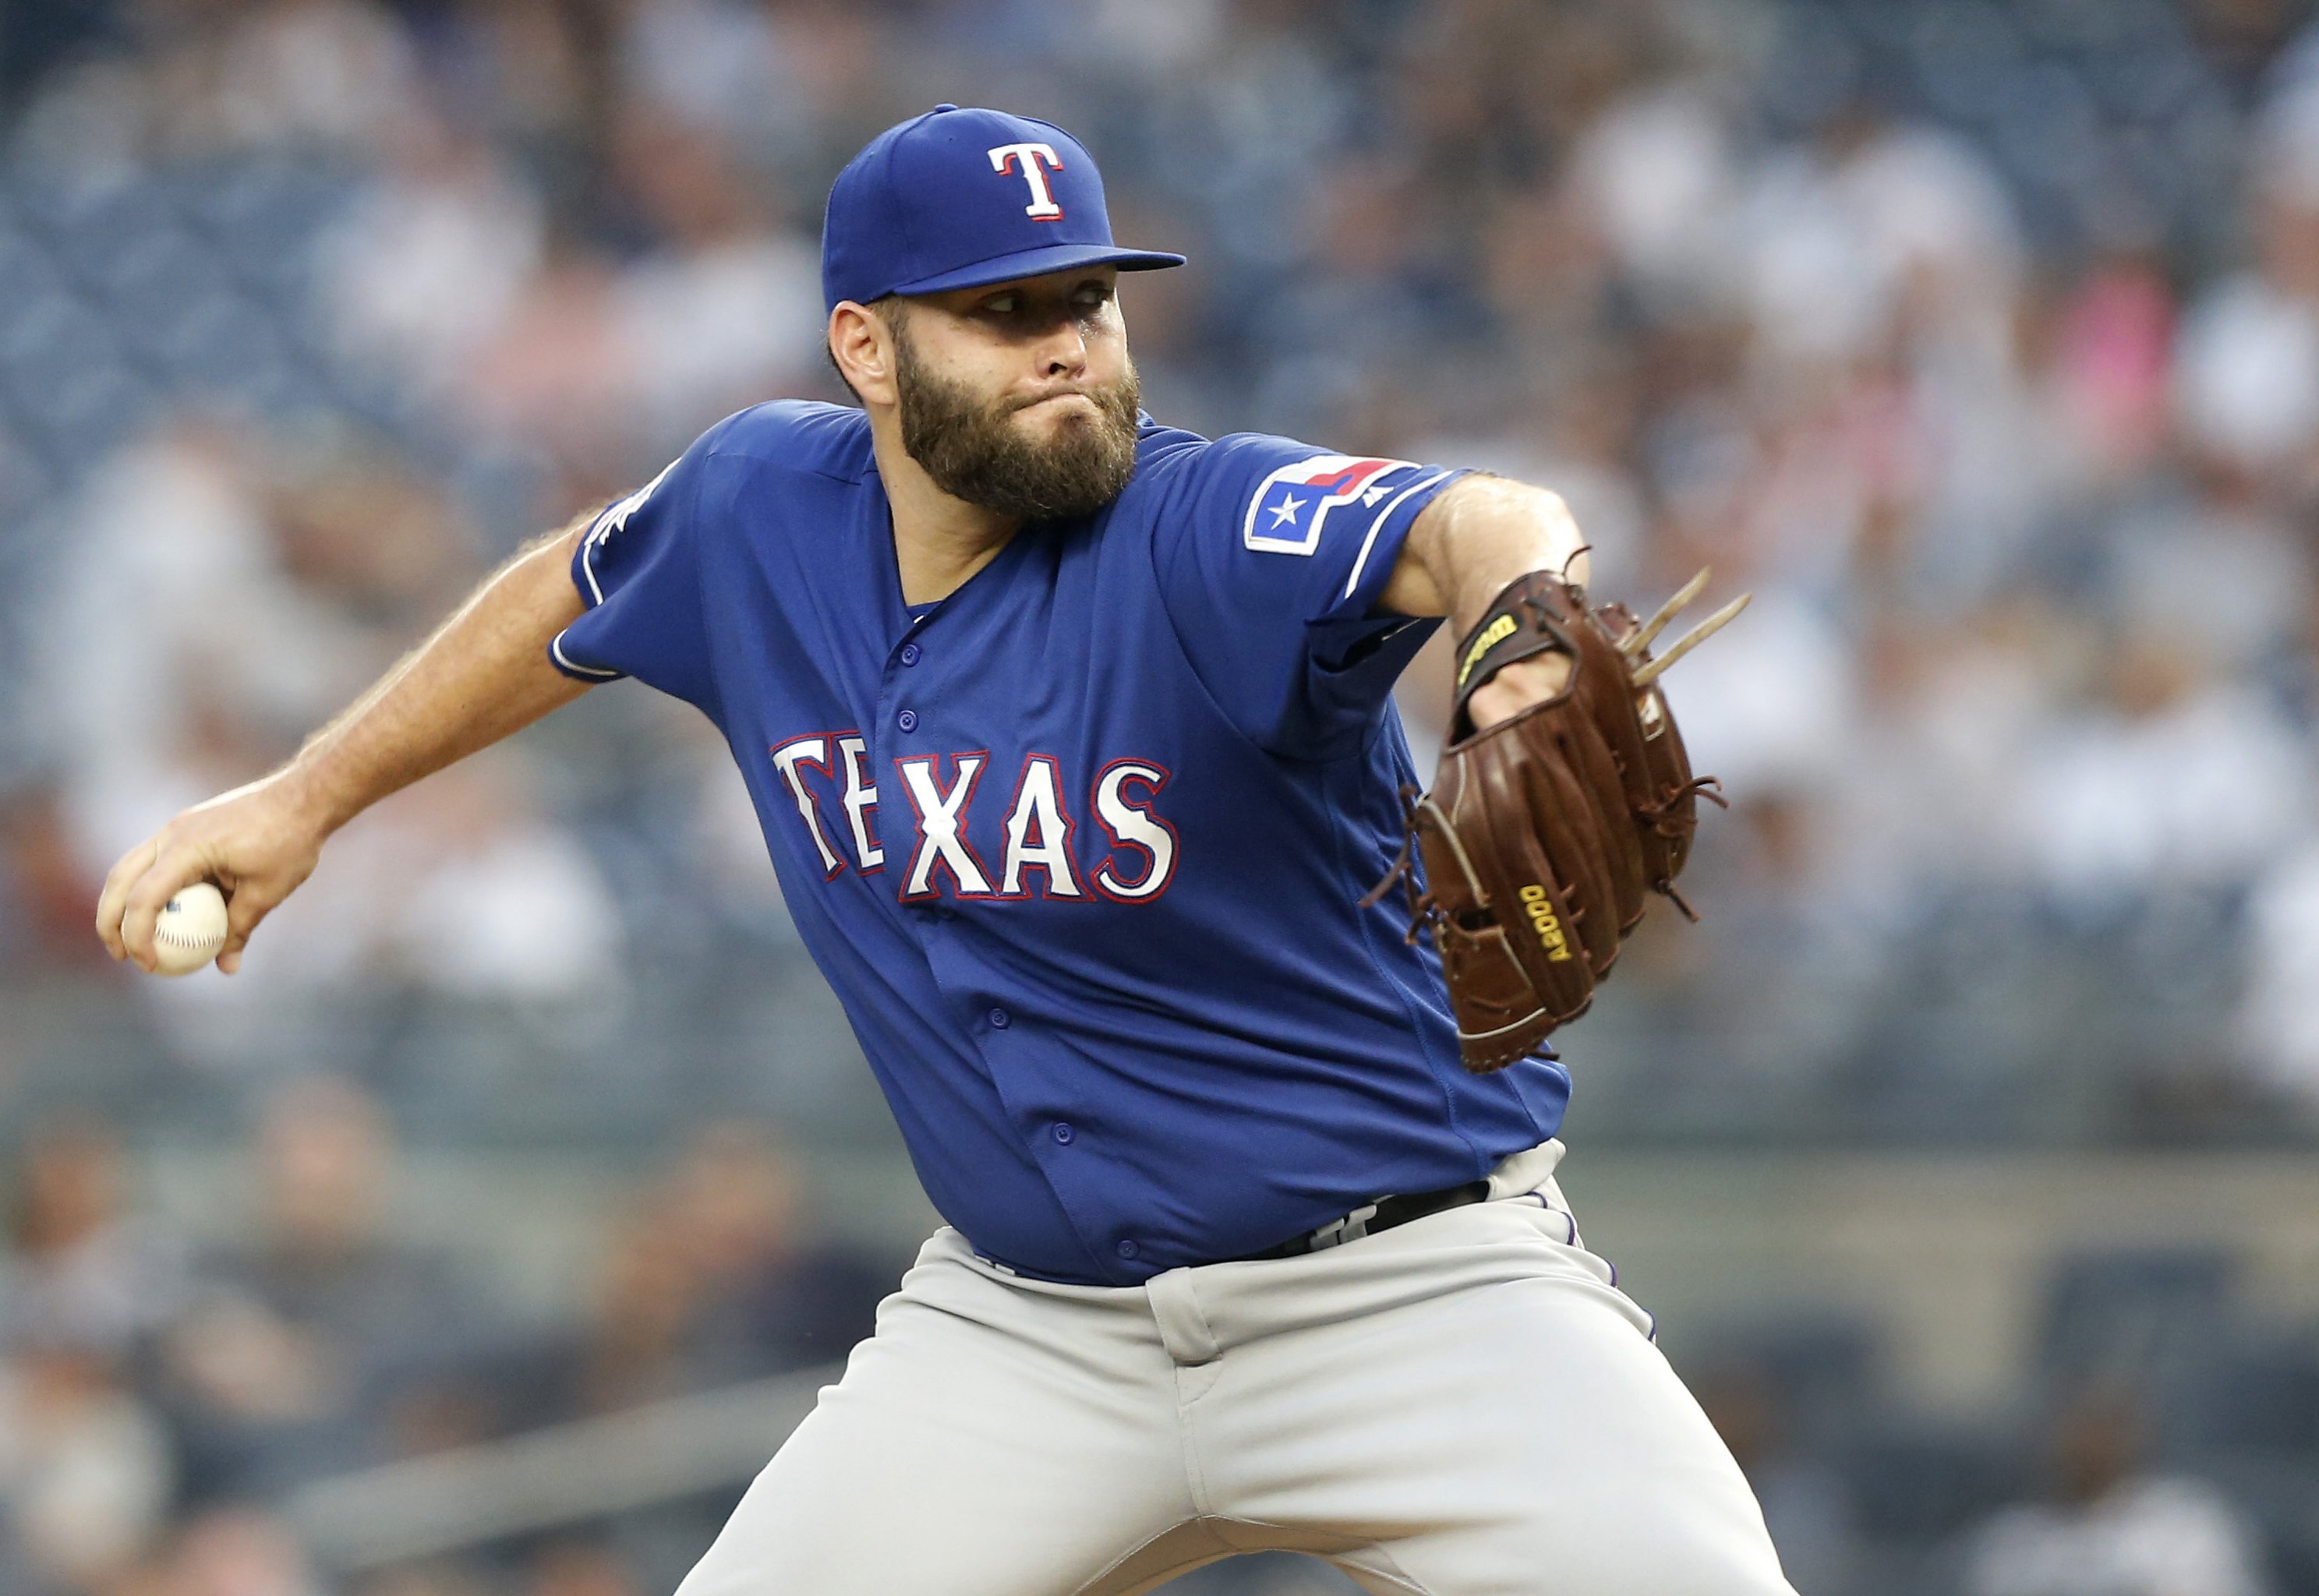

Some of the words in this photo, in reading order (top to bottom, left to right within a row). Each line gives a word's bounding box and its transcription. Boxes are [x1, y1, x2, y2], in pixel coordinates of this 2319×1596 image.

[987, 142, 1064, 222] T
[770, 730, 1179, 904] TEXAS
[1519, 885, 1572, 962] A2000
